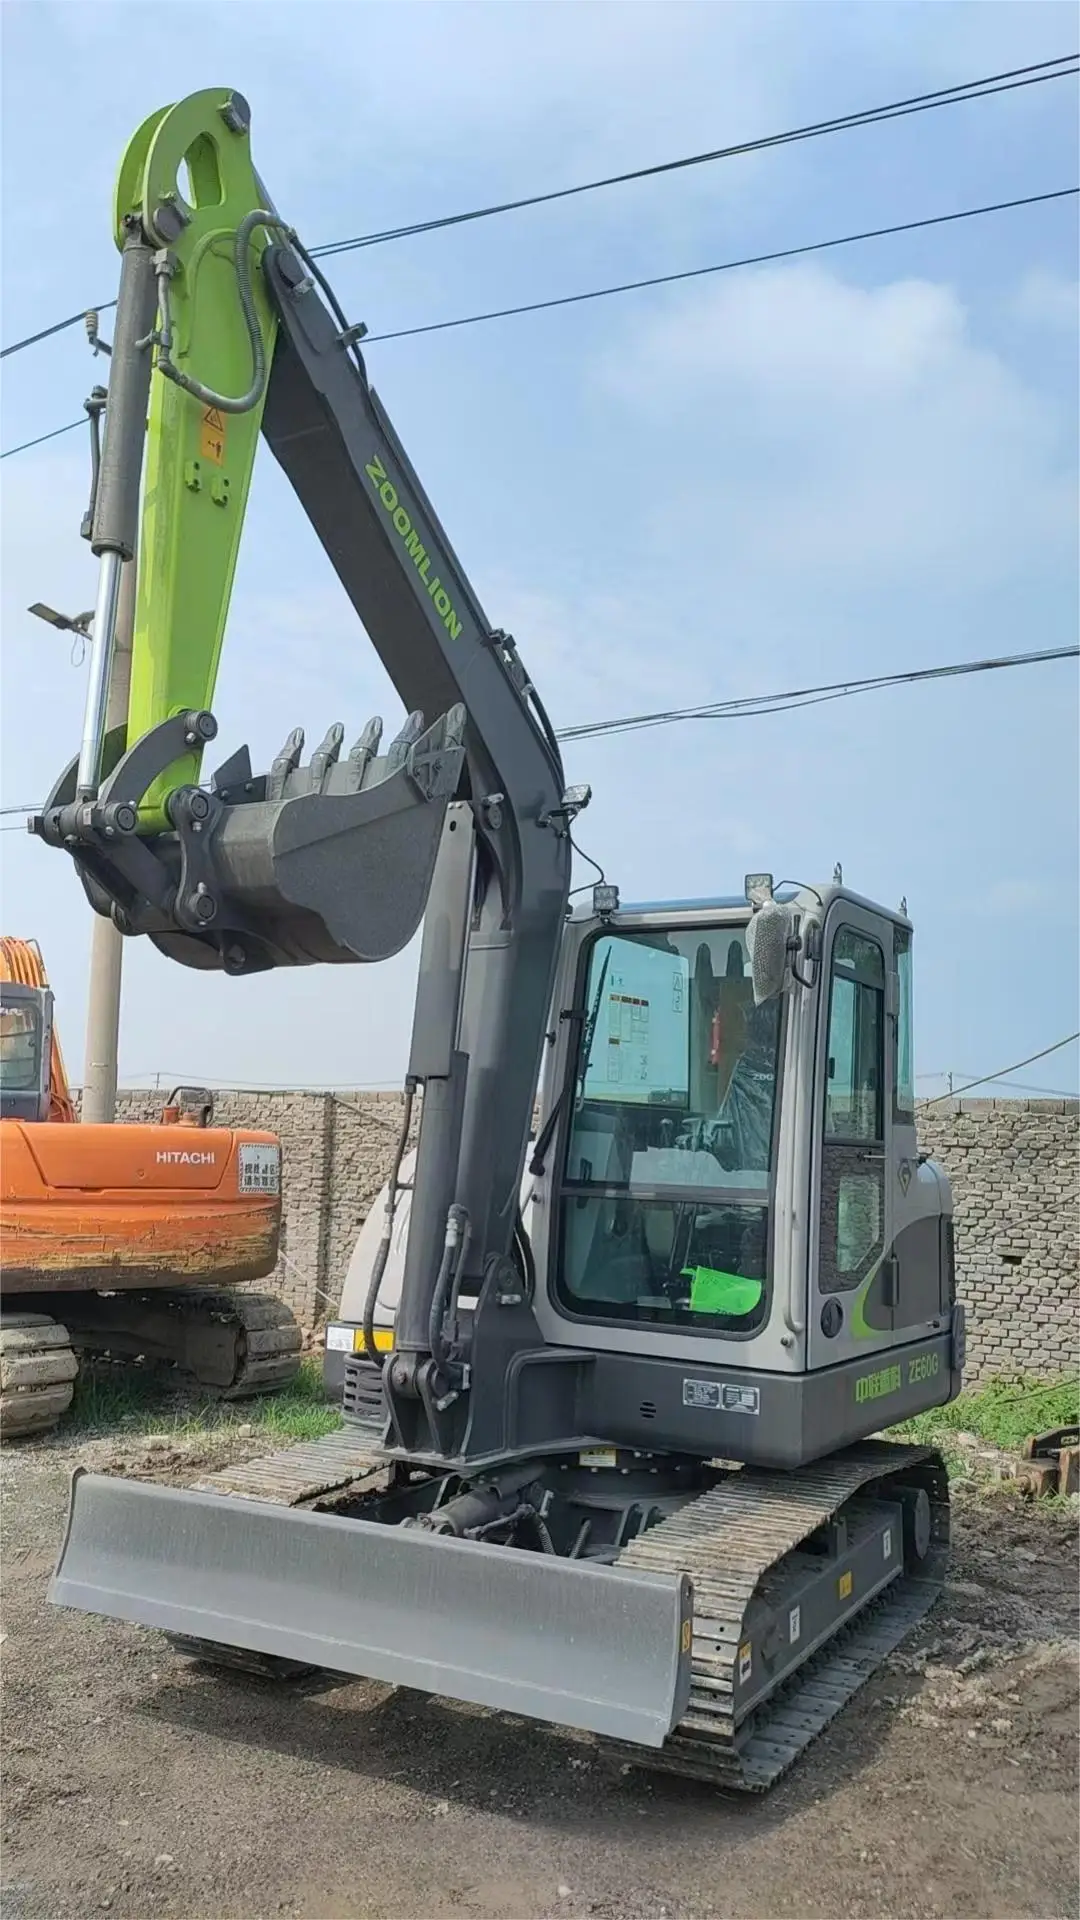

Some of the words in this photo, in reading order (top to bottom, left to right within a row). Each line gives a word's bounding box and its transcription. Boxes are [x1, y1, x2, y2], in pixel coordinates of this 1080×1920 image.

[364, 454, 463, 640] ZOOMLION
[156, 1151, 215, 1164] HITACHI
[908, 1353, 939, 1384] ZE60G
